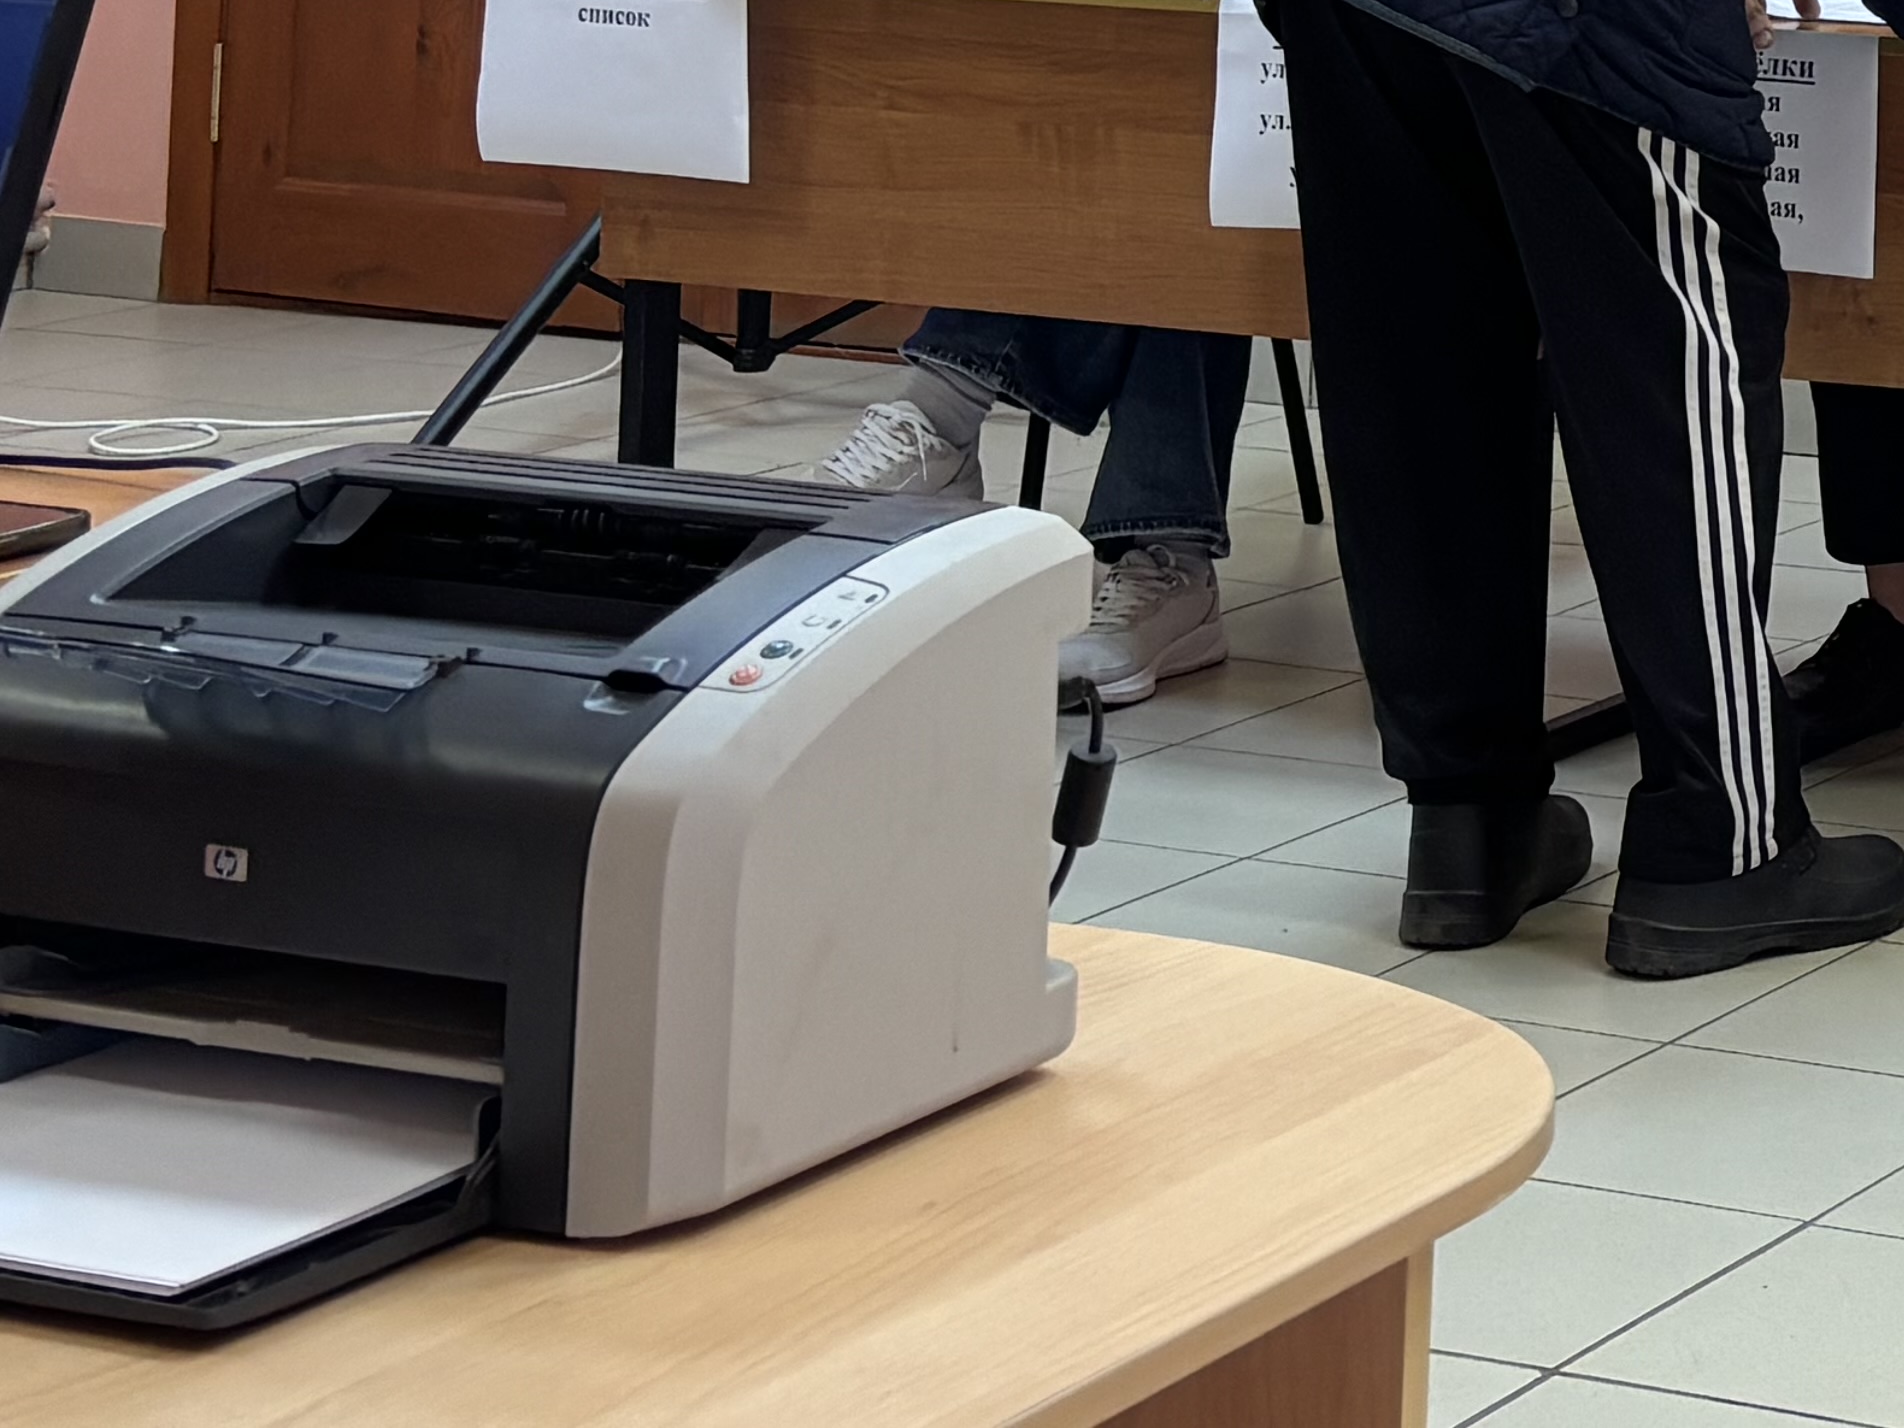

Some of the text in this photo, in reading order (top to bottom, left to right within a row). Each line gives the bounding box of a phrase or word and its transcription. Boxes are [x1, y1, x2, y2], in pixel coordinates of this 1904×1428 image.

[577, 4, 650, 28] список
[1260, 62, 1285, 84] ул
[1259, 114, 1291, 135] ул.
